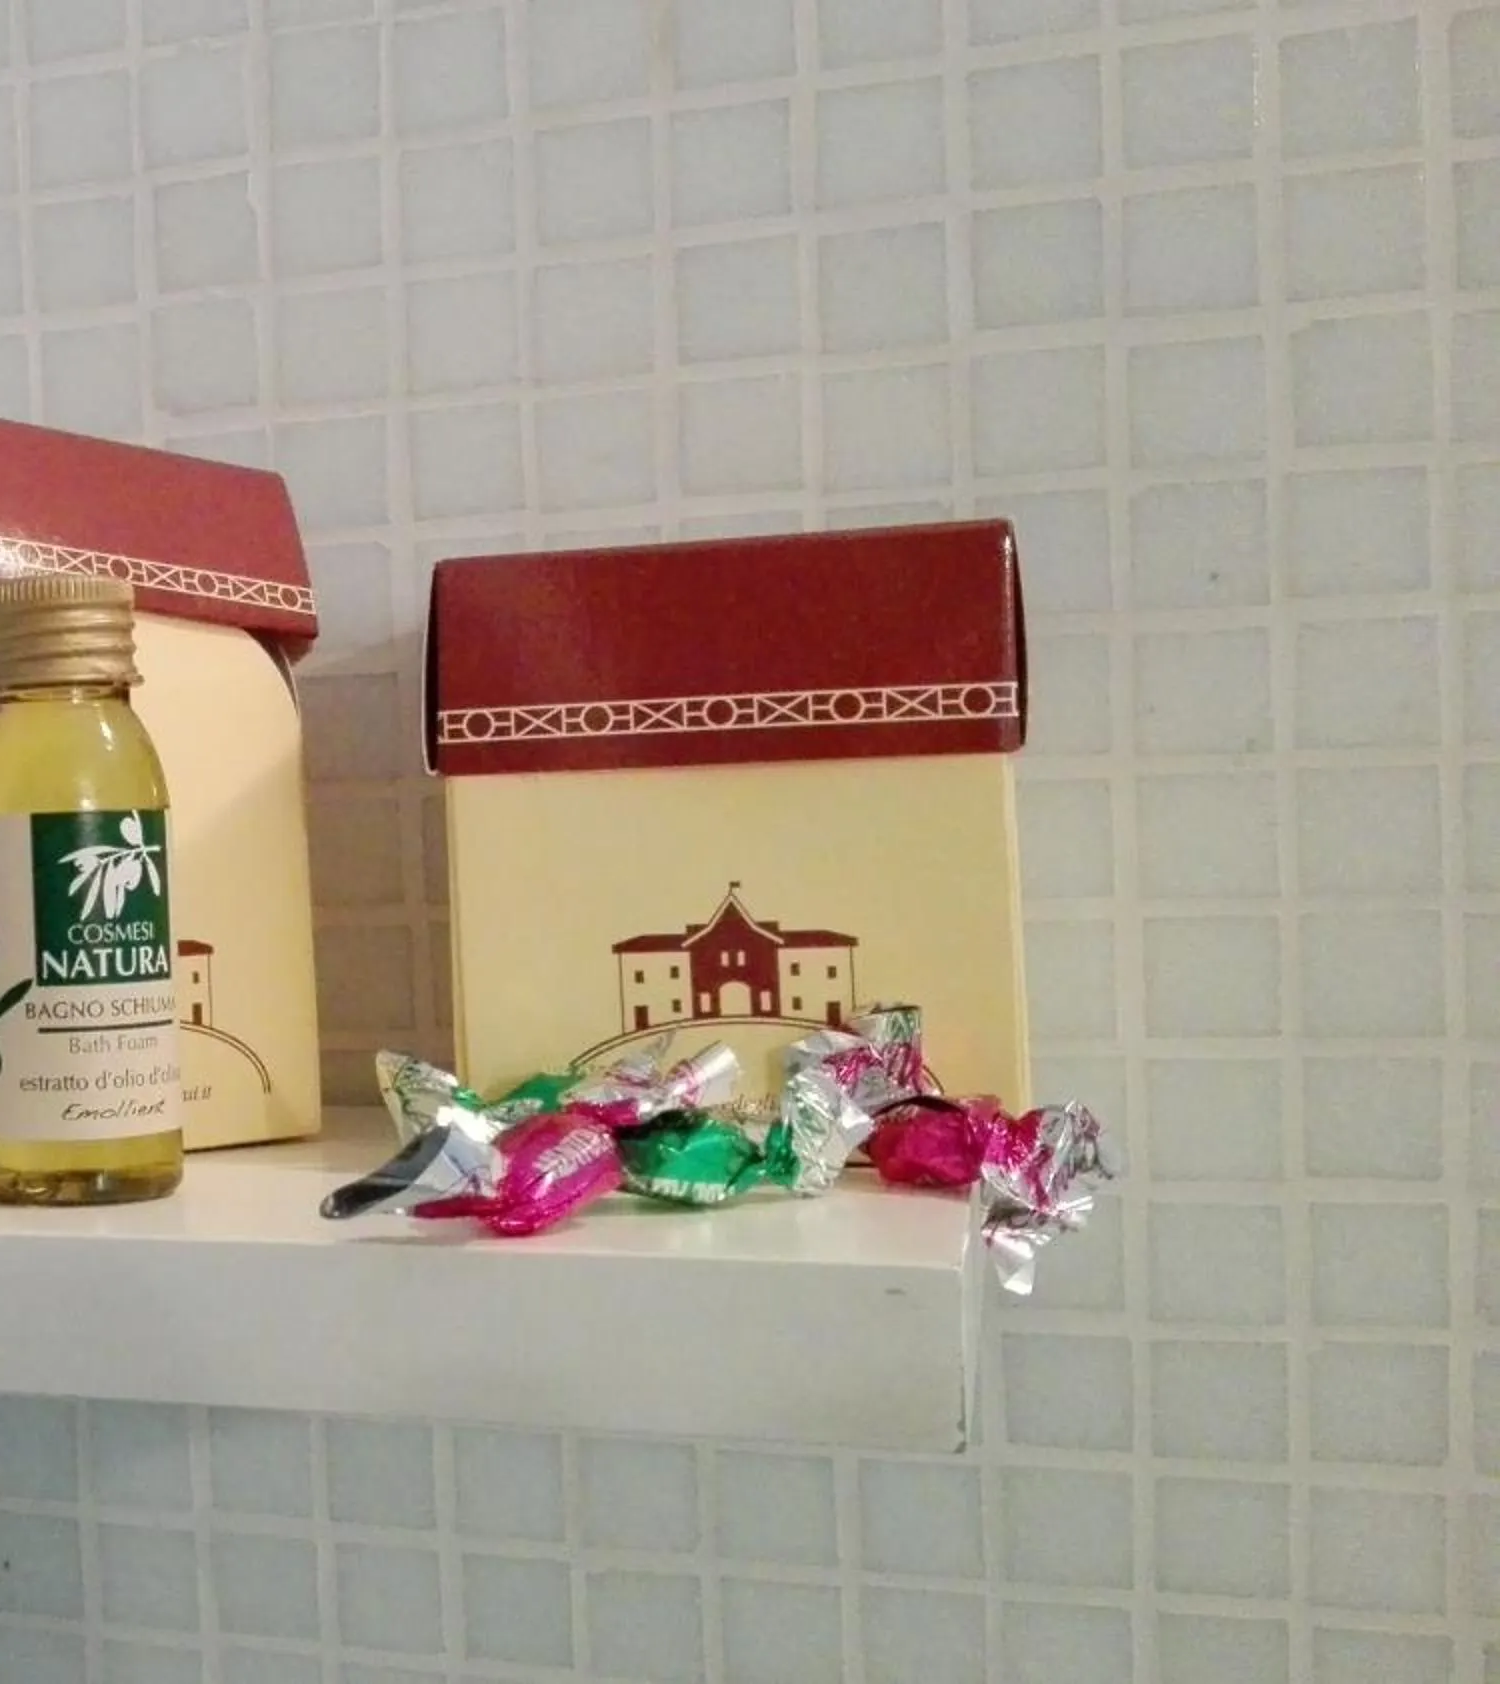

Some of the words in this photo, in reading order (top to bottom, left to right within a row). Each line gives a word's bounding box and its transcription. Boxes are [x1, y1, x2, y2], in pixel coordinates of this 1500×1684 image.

[67, 920, 155, 945] COSMESI
[41, 943, 169, 980] NATURA
[25, 999, 104, 1020] BAGNO
[68, 1034, 112, 1054] Bath
[117, 1034, 159, 1051] Foam
[19, 1072, 89, 1092] estratto
[95, 1066, 145, 1090] d'olio
[61, 1099, 166, 1121] Emollient
